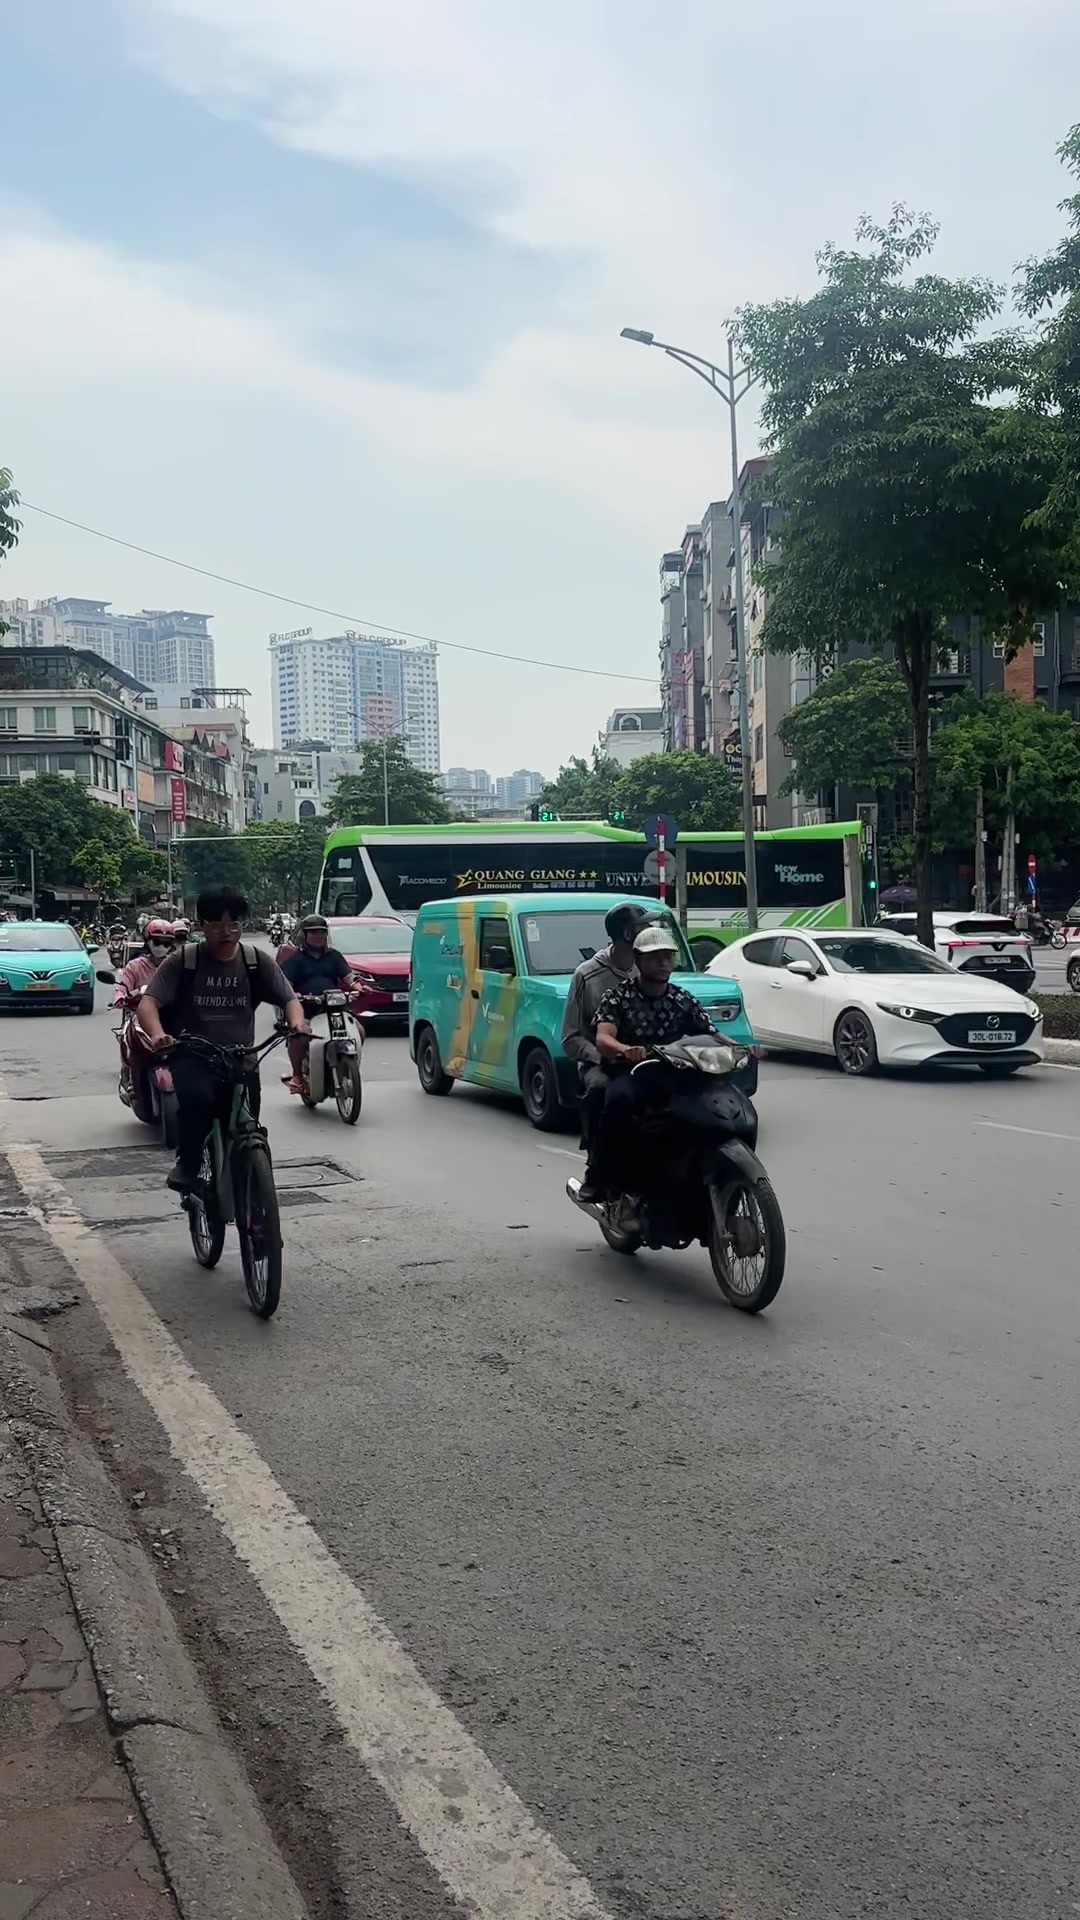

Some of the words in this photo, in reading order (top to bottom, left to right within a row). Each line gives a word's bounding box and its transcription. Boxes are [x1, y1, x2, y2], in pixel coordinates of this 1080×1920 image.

[376, 636, 407, 647] GROUP
[774, 864, 798, 873] New
[474, 869, 525, 880] QUANG
[530, 869, 576, 880] GIANG
[780, 871, 825, 882] Home
[206, 976, 238, 987] MADE
